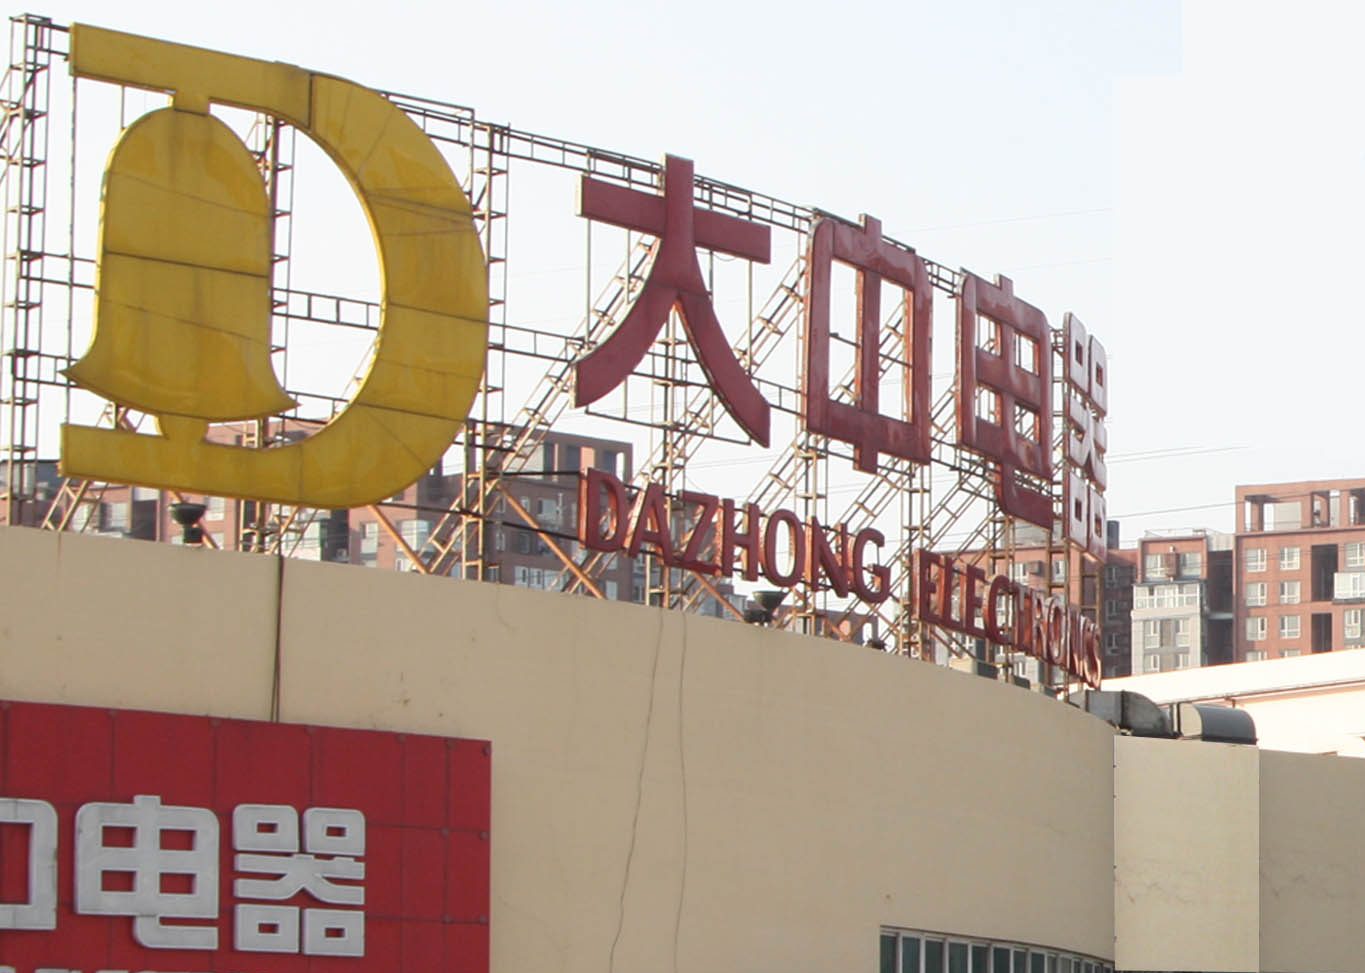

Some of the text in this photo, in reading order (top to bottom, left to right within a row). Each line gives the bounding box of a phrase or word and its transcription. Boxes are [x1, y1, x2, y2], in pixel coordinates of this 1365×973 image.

[575, 153, 1108, 563] 大中电器
[579, 467, 891, 604] DAZHONG
